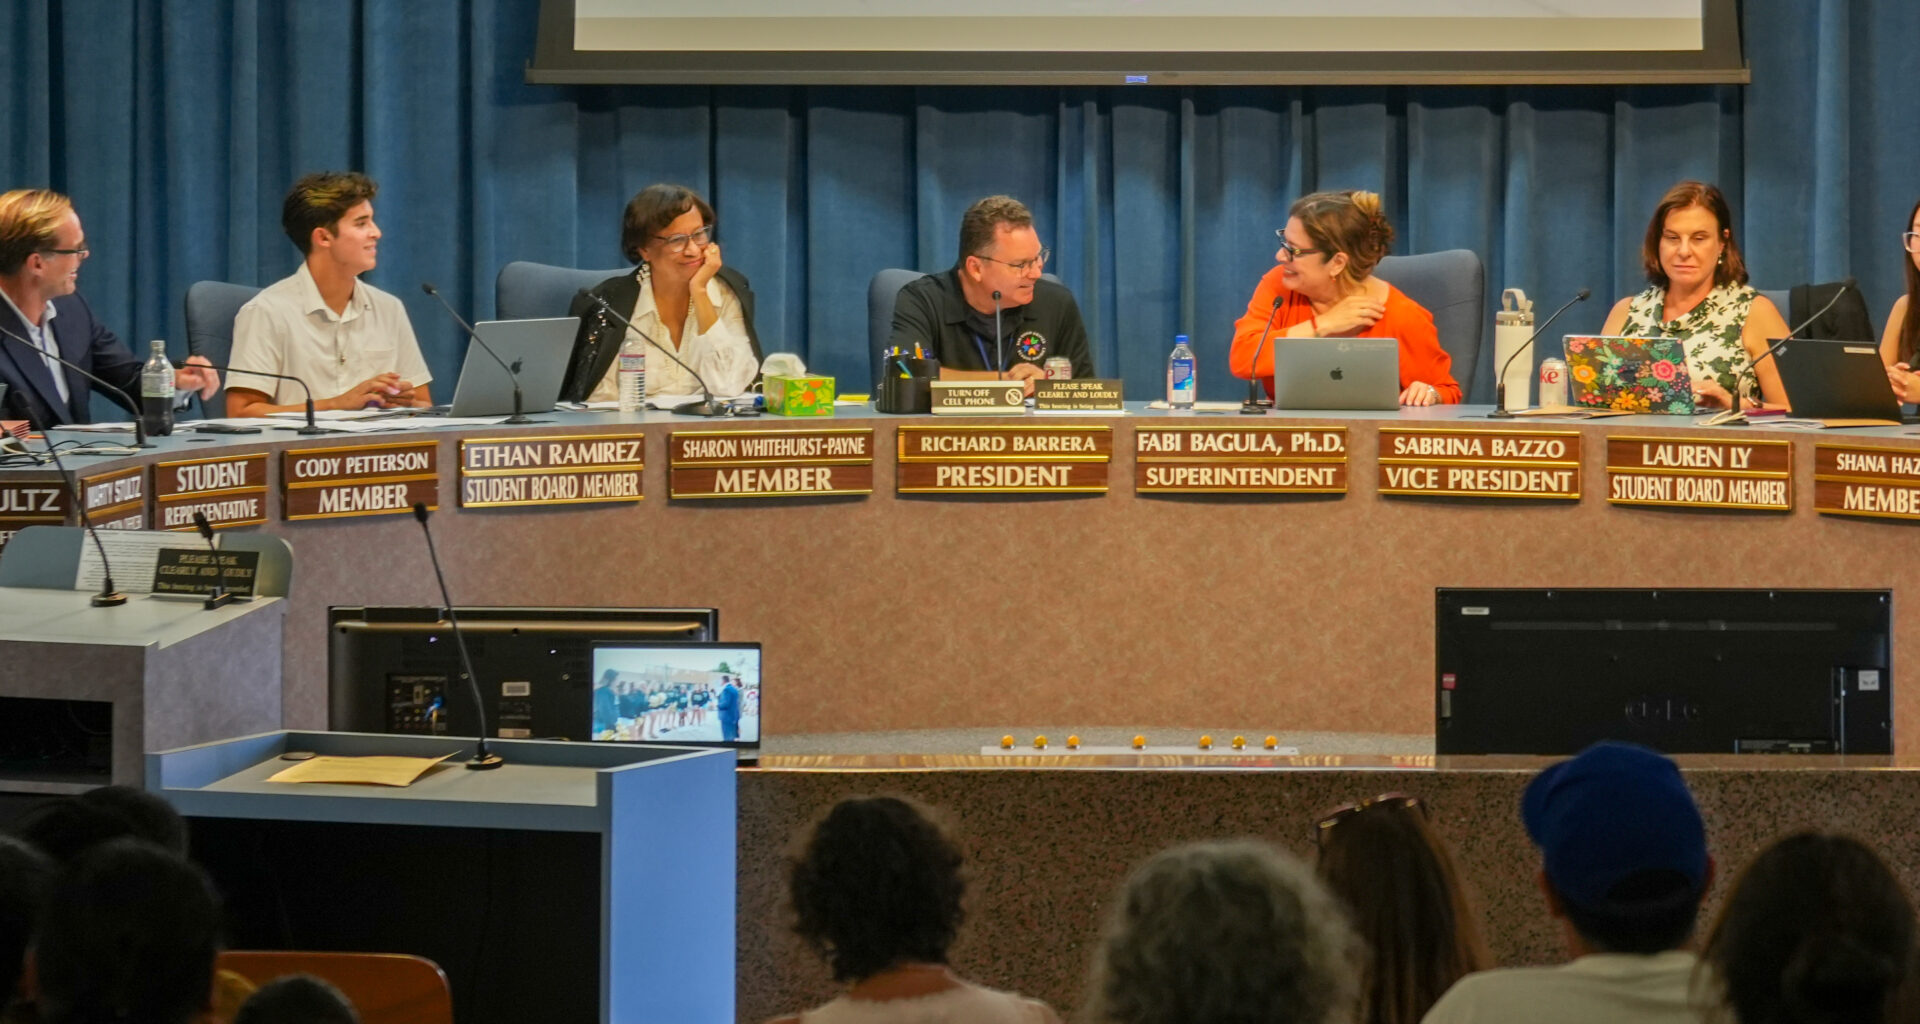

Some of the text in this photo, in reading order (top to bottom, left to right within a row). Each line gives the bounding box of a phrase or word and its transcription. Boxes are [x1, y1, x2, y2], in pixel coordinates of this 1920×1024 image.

[943, 398, 995, 406] CELL PHONE
[948, 389, 990, 397] TURN OFF
[470, 441, 641, 467] ETHAN RAMIREZ
[682, 438, 865, 458] SHARON WHITEHURST-PAYNE
[920, 436, 1097, 452] RICHARD BARRERA
[1138, 432, 1345, 455] FABI BAGULA, Ph.D.
[1394, 436, 1565, 458] SABRINA BAZZO
[295, 452, 429, 478] CODY PETTERSON
[1642, 444, 1752, 468] LAUREN LY
[1837, 453, 1920, 475] SHANA HAZ
[176, 460, 249, 492] STUDENT
[714, 468, 833, 492] MEMBER
[936, 466, 1072, 486] PRESIDENT
[1146, 467, 1337, 486] SUPERINTENDENT
[1385, 467, 1573, 492] VICE PRESIDENT
[318, 484, 408, 514] MEMBER
[467, 473, 638, 503] STUDENT BOARD MEMBER
[1613, 475, 1786, 504] STUDENT BOARD MEMBER
[1843, 485, 1920, 514] MEMBE
[211, 556, 237, 565] SEAK
